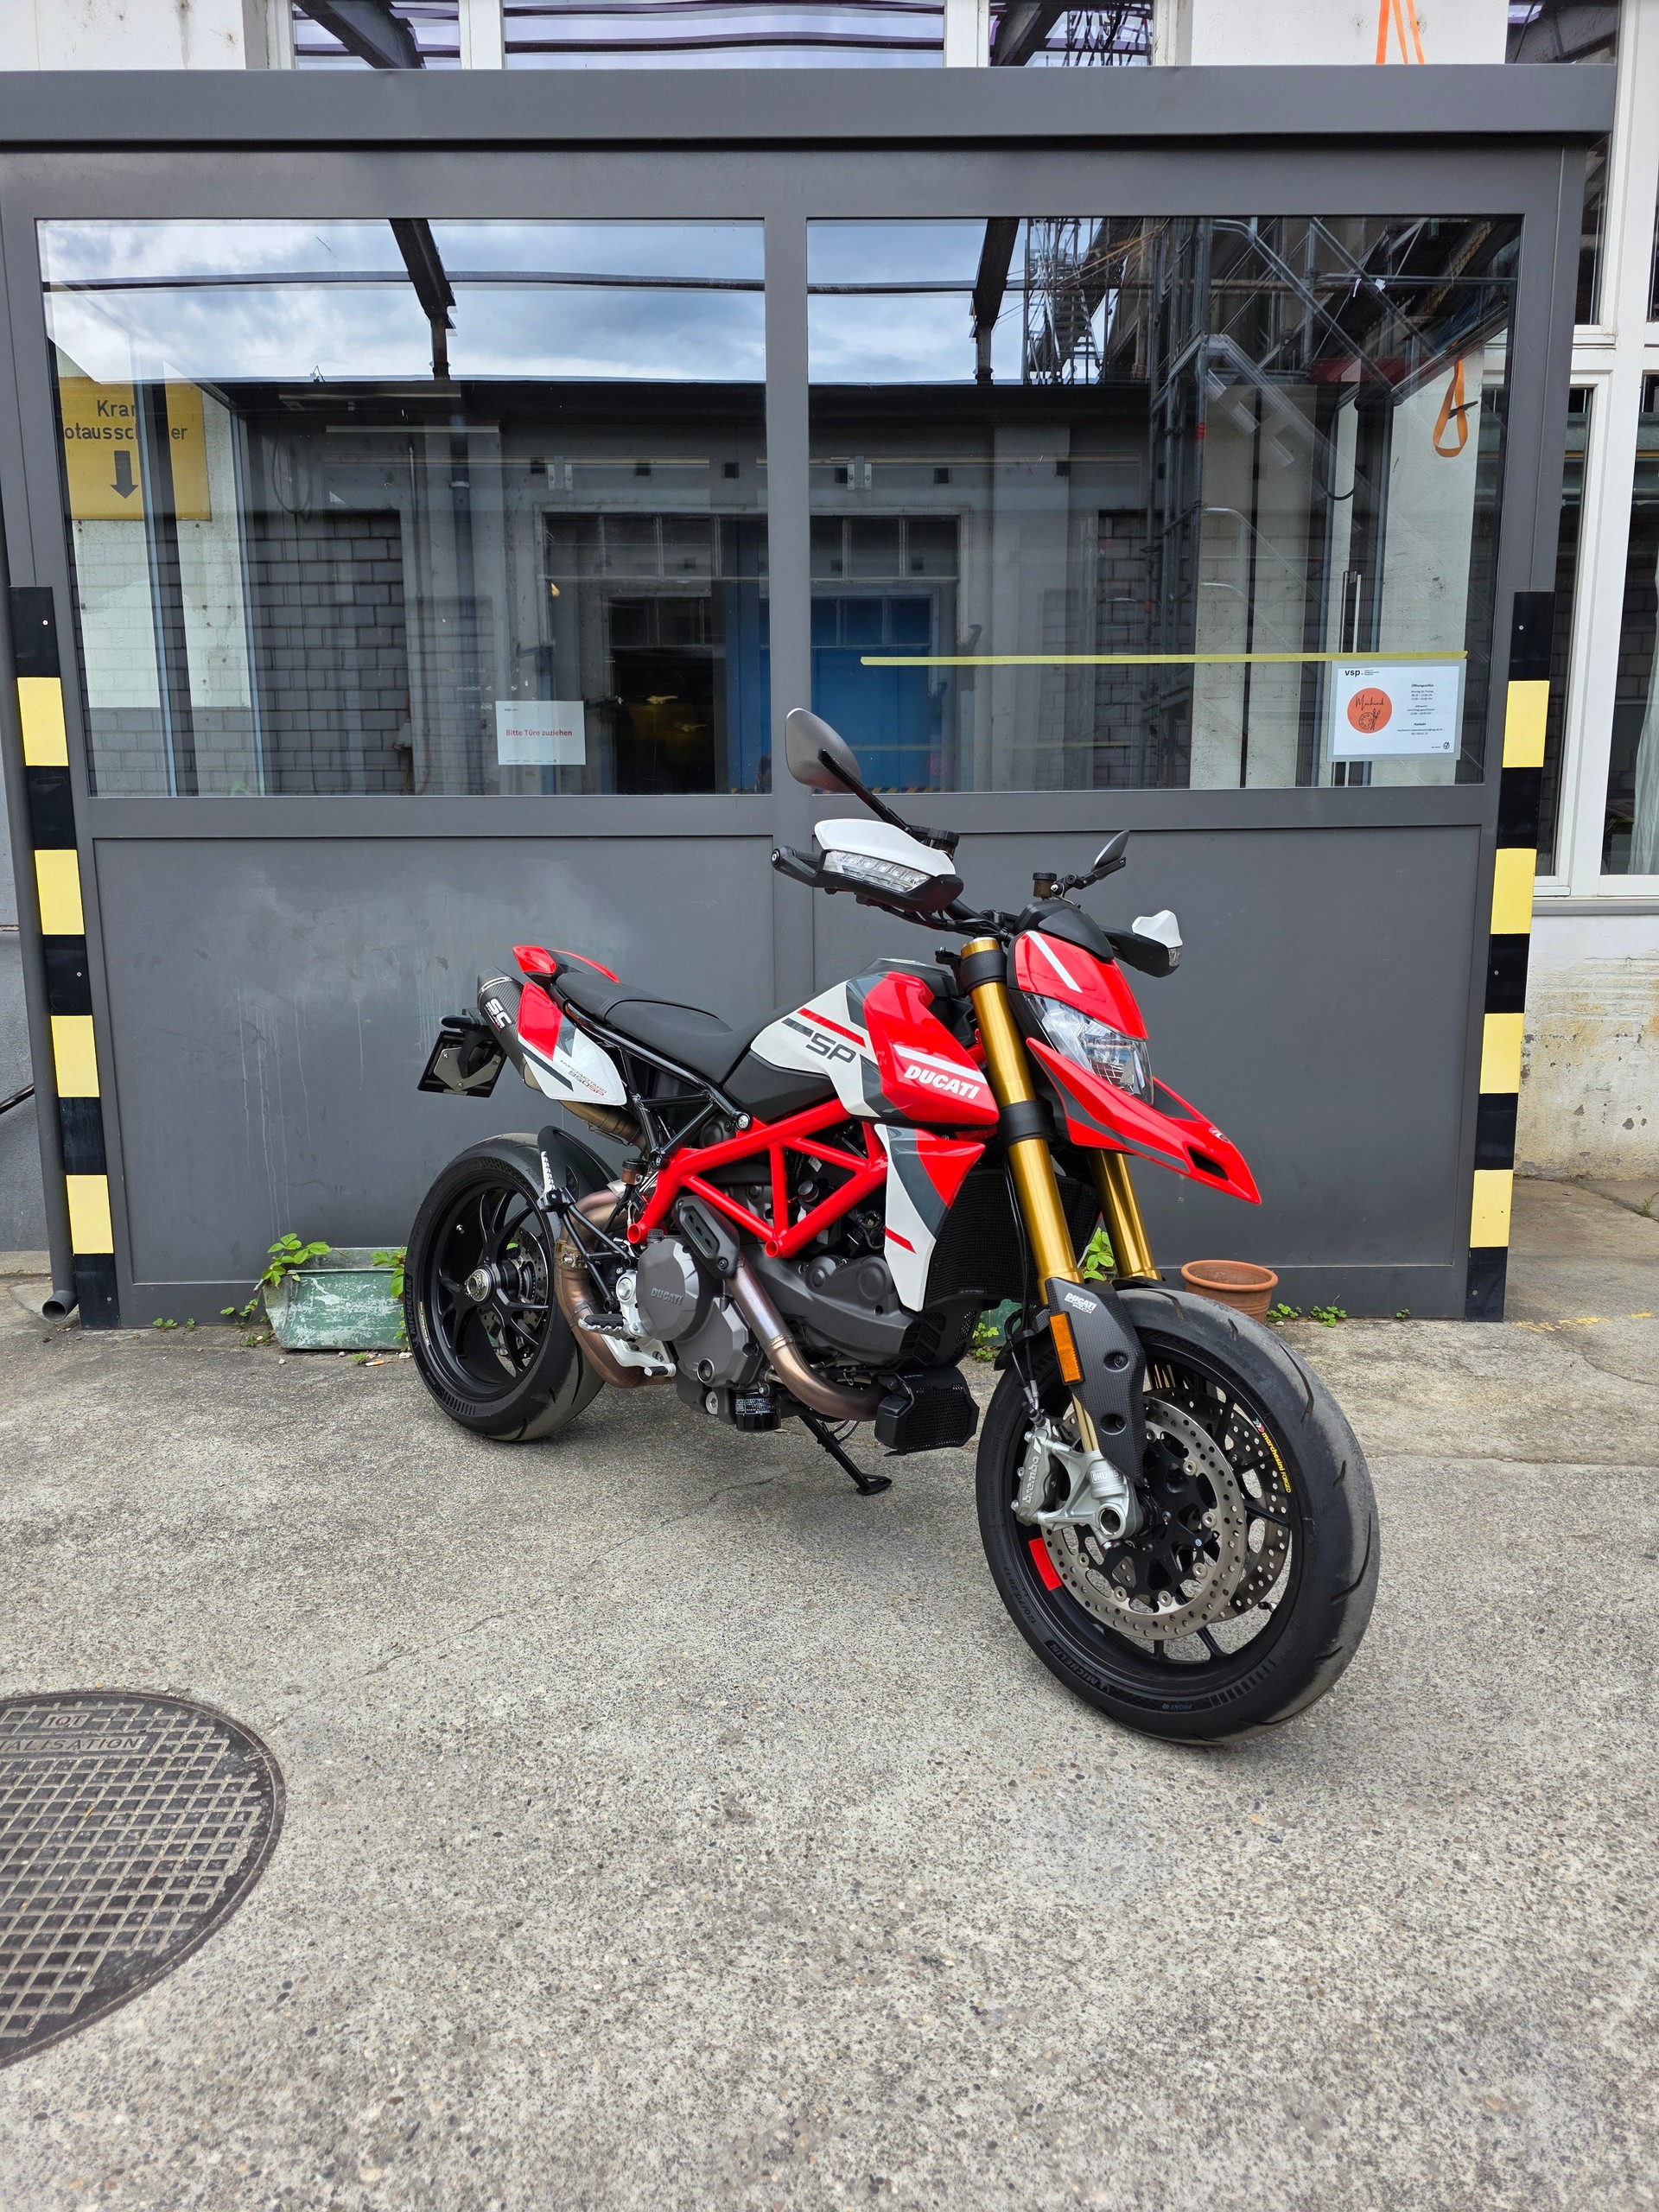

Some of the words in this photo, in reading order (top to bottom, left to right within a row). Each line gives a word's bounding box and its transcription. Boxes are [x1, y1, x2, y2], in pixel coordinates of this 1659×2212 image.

[805, 1033, 857, 1064] SP
[903, 1065, 981, 1100] DUCATI
[650, 1287, 683, 1306] DUCATI
[1065, 1292, 1097, 1311] DUCATI
[1262, 1432, 1286, 1471] marchesini
[1281, 1471, 1292, 1493] FORGED
[1022, 1456, 1039, 1503] brembo
[1049, 1643, 1098, 1685] MICHELIN
[48, 1714, 86, 1727] 10T
